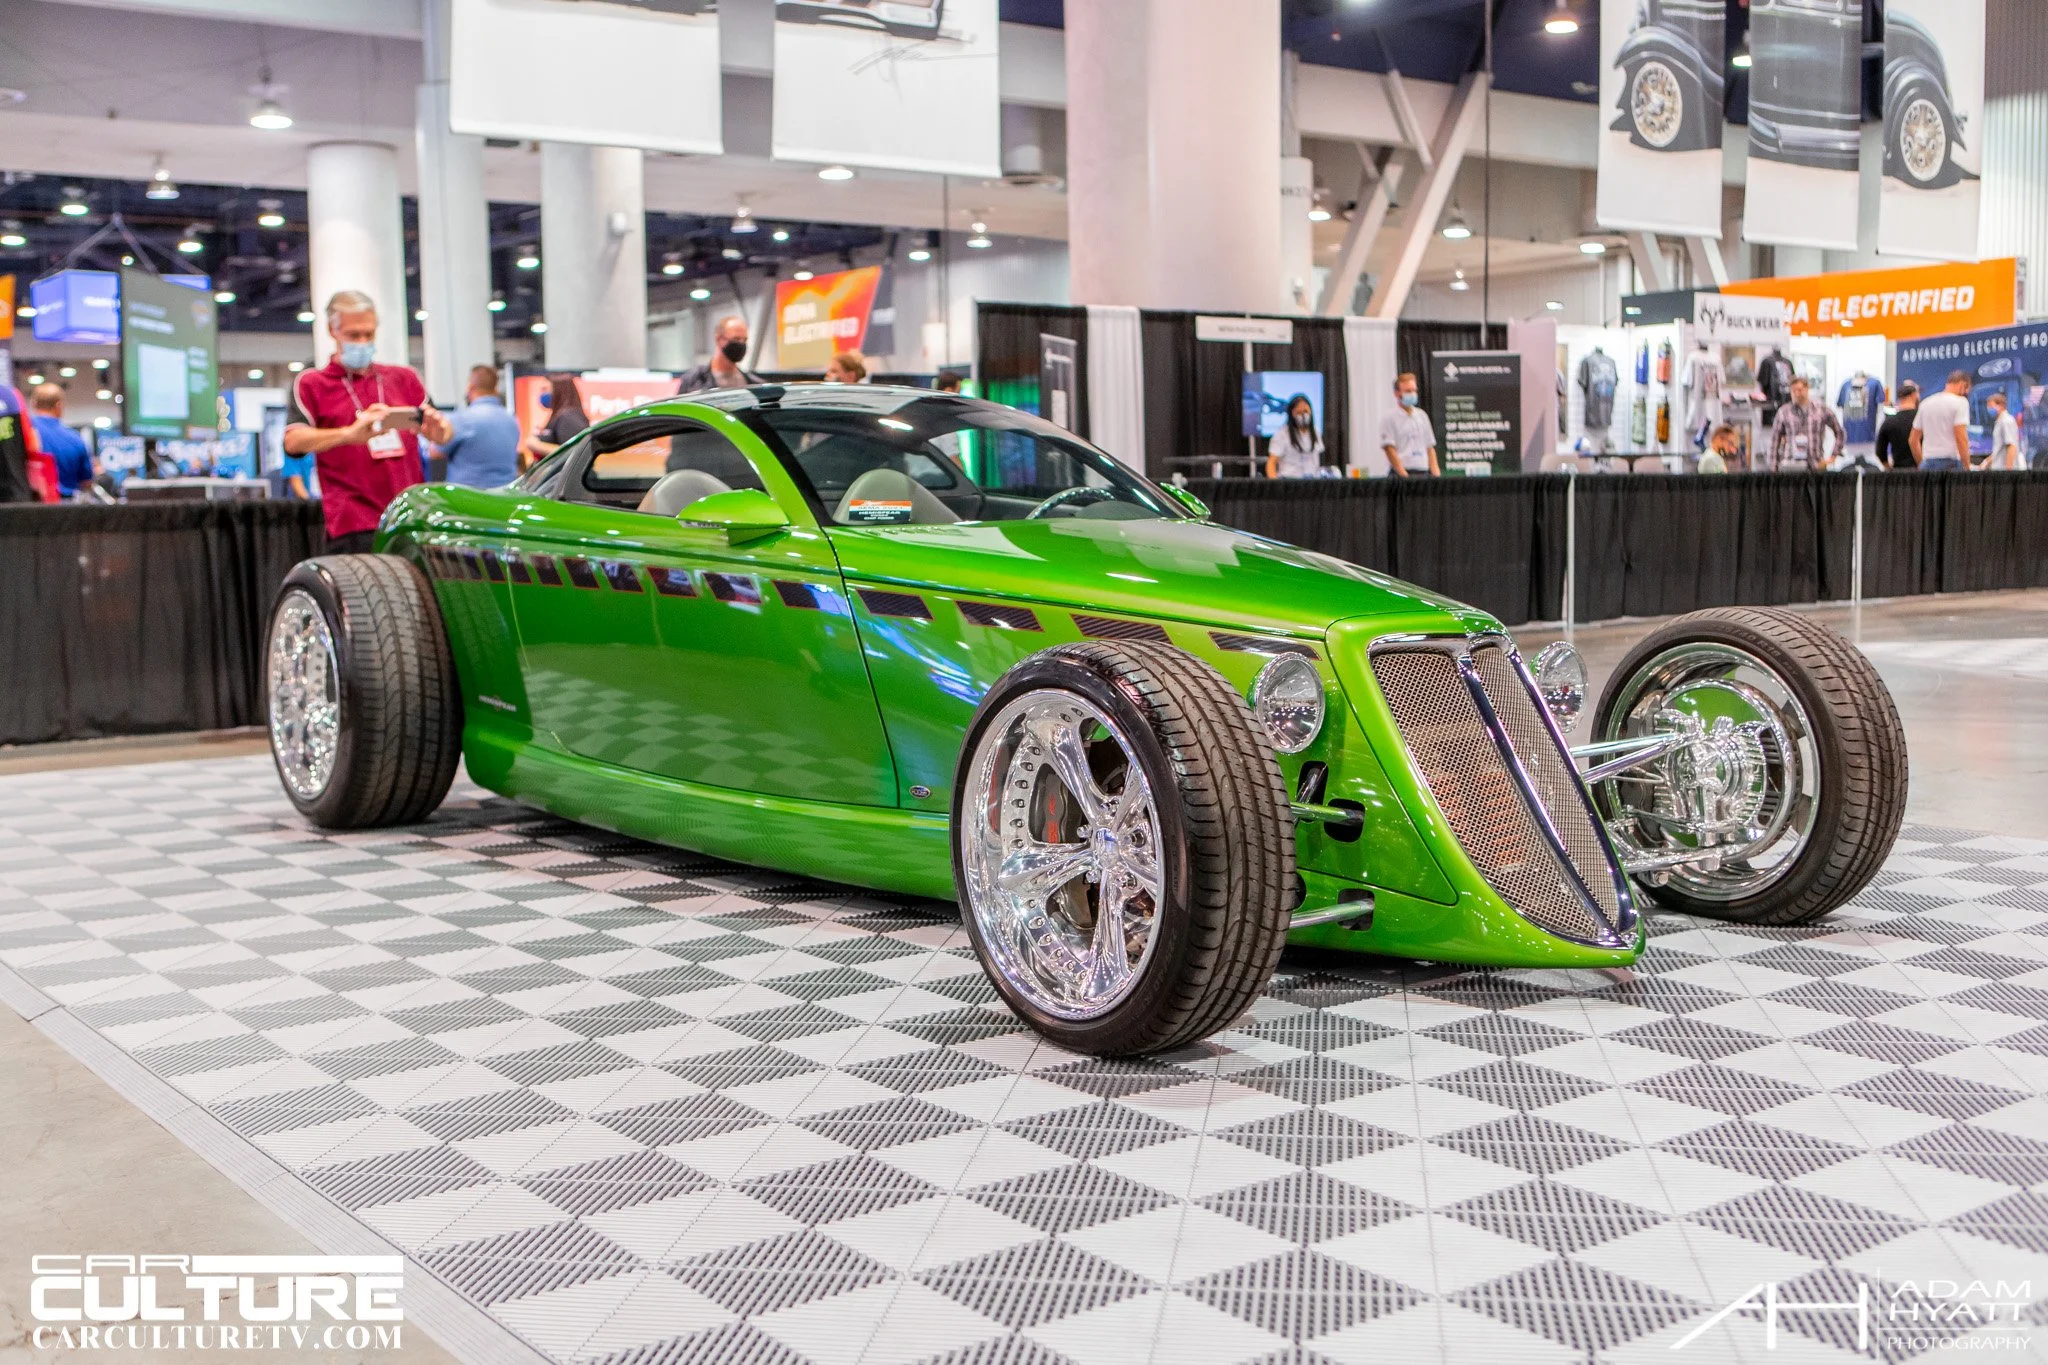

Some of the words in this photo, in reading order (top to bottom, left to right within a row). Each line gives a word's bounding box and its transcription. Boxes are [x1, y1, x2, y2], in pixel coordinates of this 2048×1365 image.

[1816, 286, 1975, 321] ELECTRIFIED
[1727, 315, 1752, 328] BUCK
[1754, 316, 1780, 329] WEAR
[1902, 342, 1960, 362] ADVANCED
[1963, 335, 2019, 357] ELECTRIC
[2023, 331, 2048, 348] PRO
